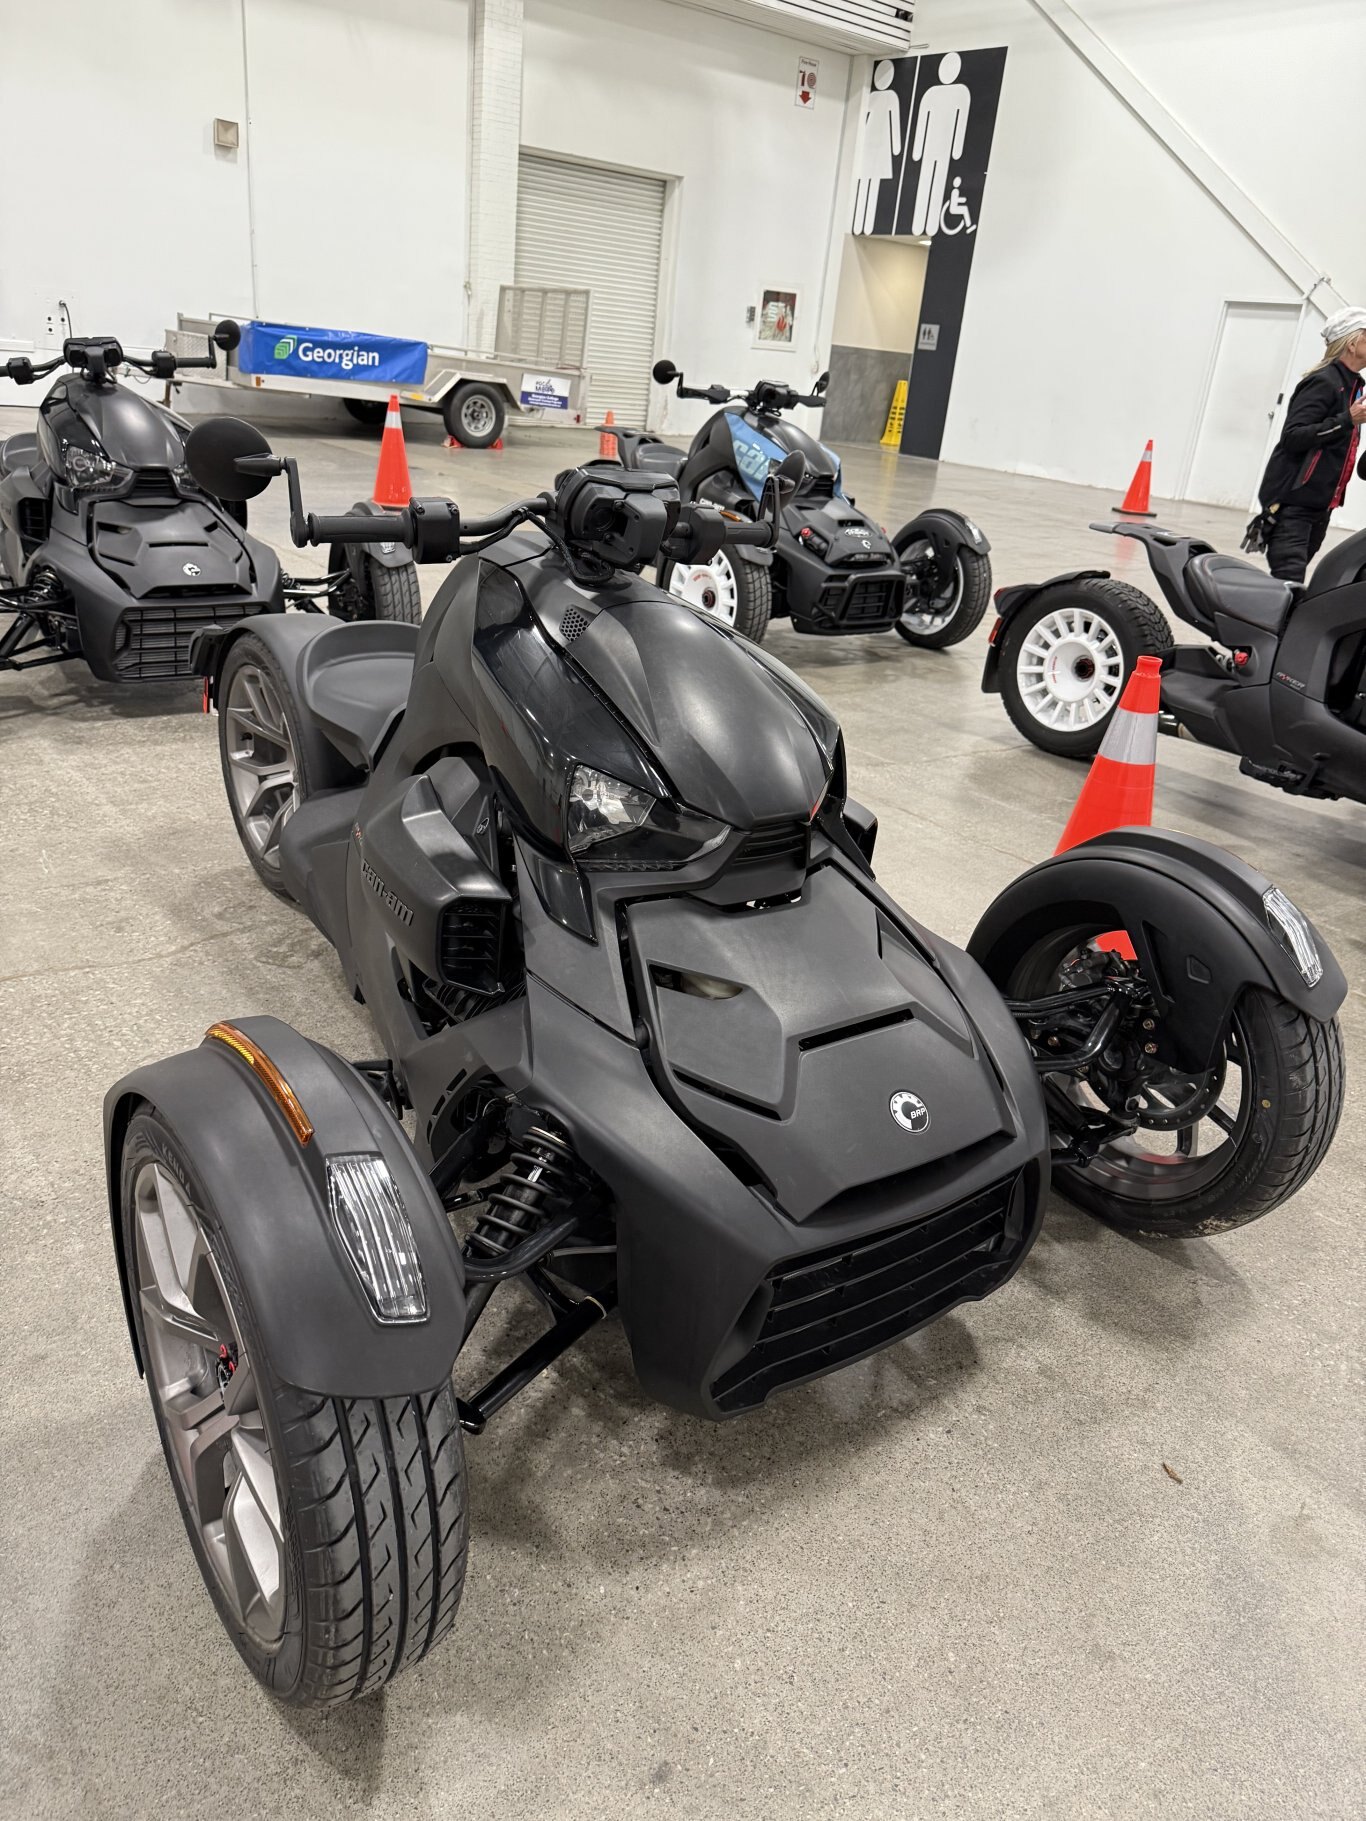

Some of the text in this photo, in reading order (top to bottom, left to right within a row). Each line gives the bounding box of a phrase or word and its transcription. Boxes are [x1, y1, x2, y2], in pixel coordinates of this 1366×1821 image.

[298, 342, 379, 370] Georgian
[361, 858, 414, 927] can-am
[910, 1107, 926, 1119] BRP
[161, 1143, 192, 1199] KENDA
